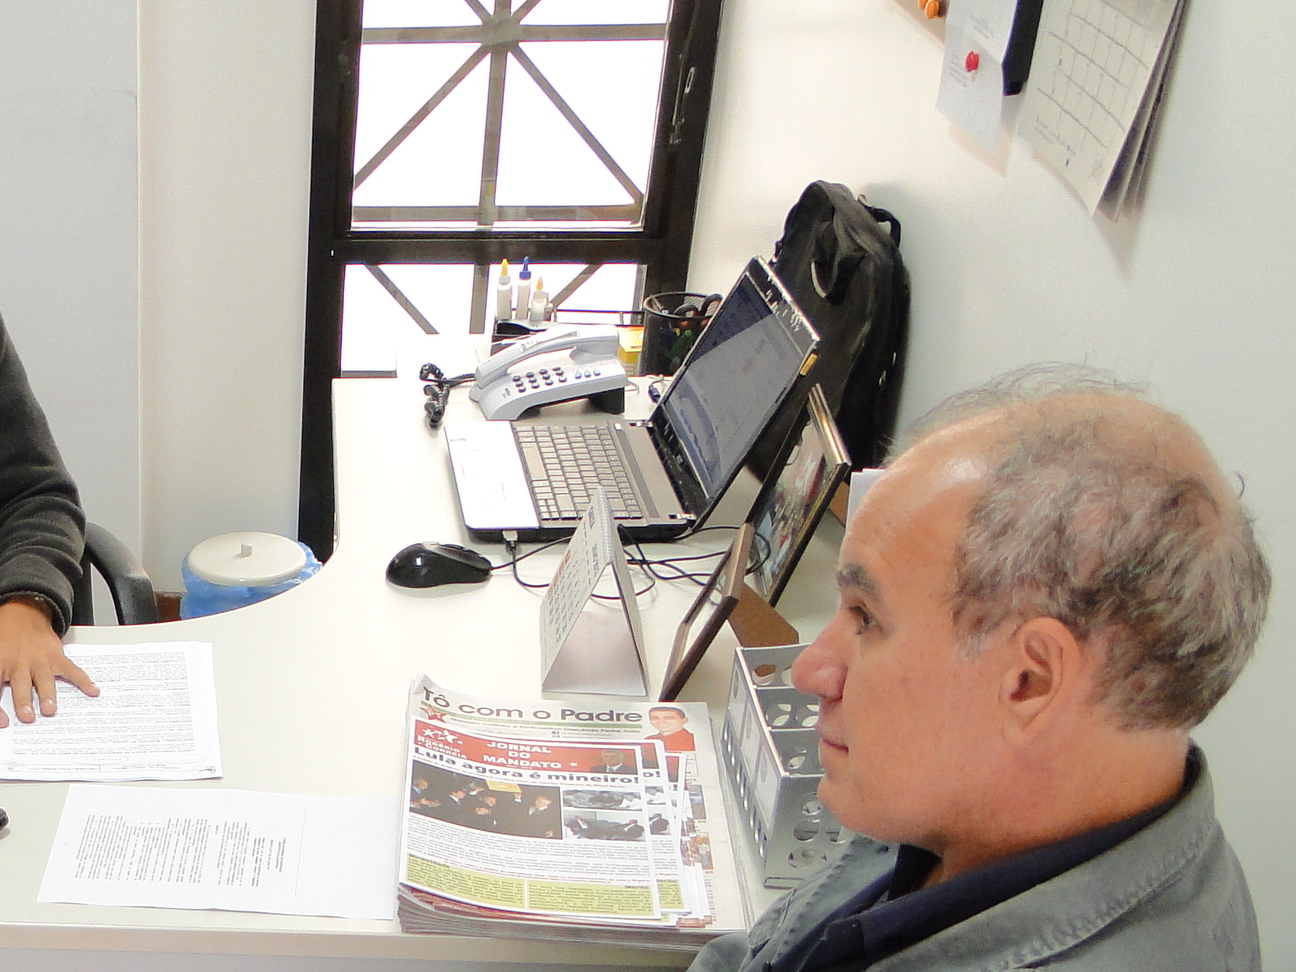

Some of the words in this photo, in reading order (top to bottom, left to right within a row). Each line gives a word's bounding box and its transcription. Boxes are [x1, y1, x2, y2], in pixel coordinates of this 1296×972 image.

[423, 686, 450, 707] Tô
[458, 704, 523, 718] com
[533, 710, 551, 720] o
[561, 708, 643, 722] Padre
[487, 742, 552, 753] JORNAL
[508, 750, 531, 758] DO
[415, 747, 456, 765] Lula
[462, 762, 523, 778] agora
[529, 771, 541, 780] é
[548, 773, 639, 784] mineiro!
[483, 755, 562, 769] MANDATO
